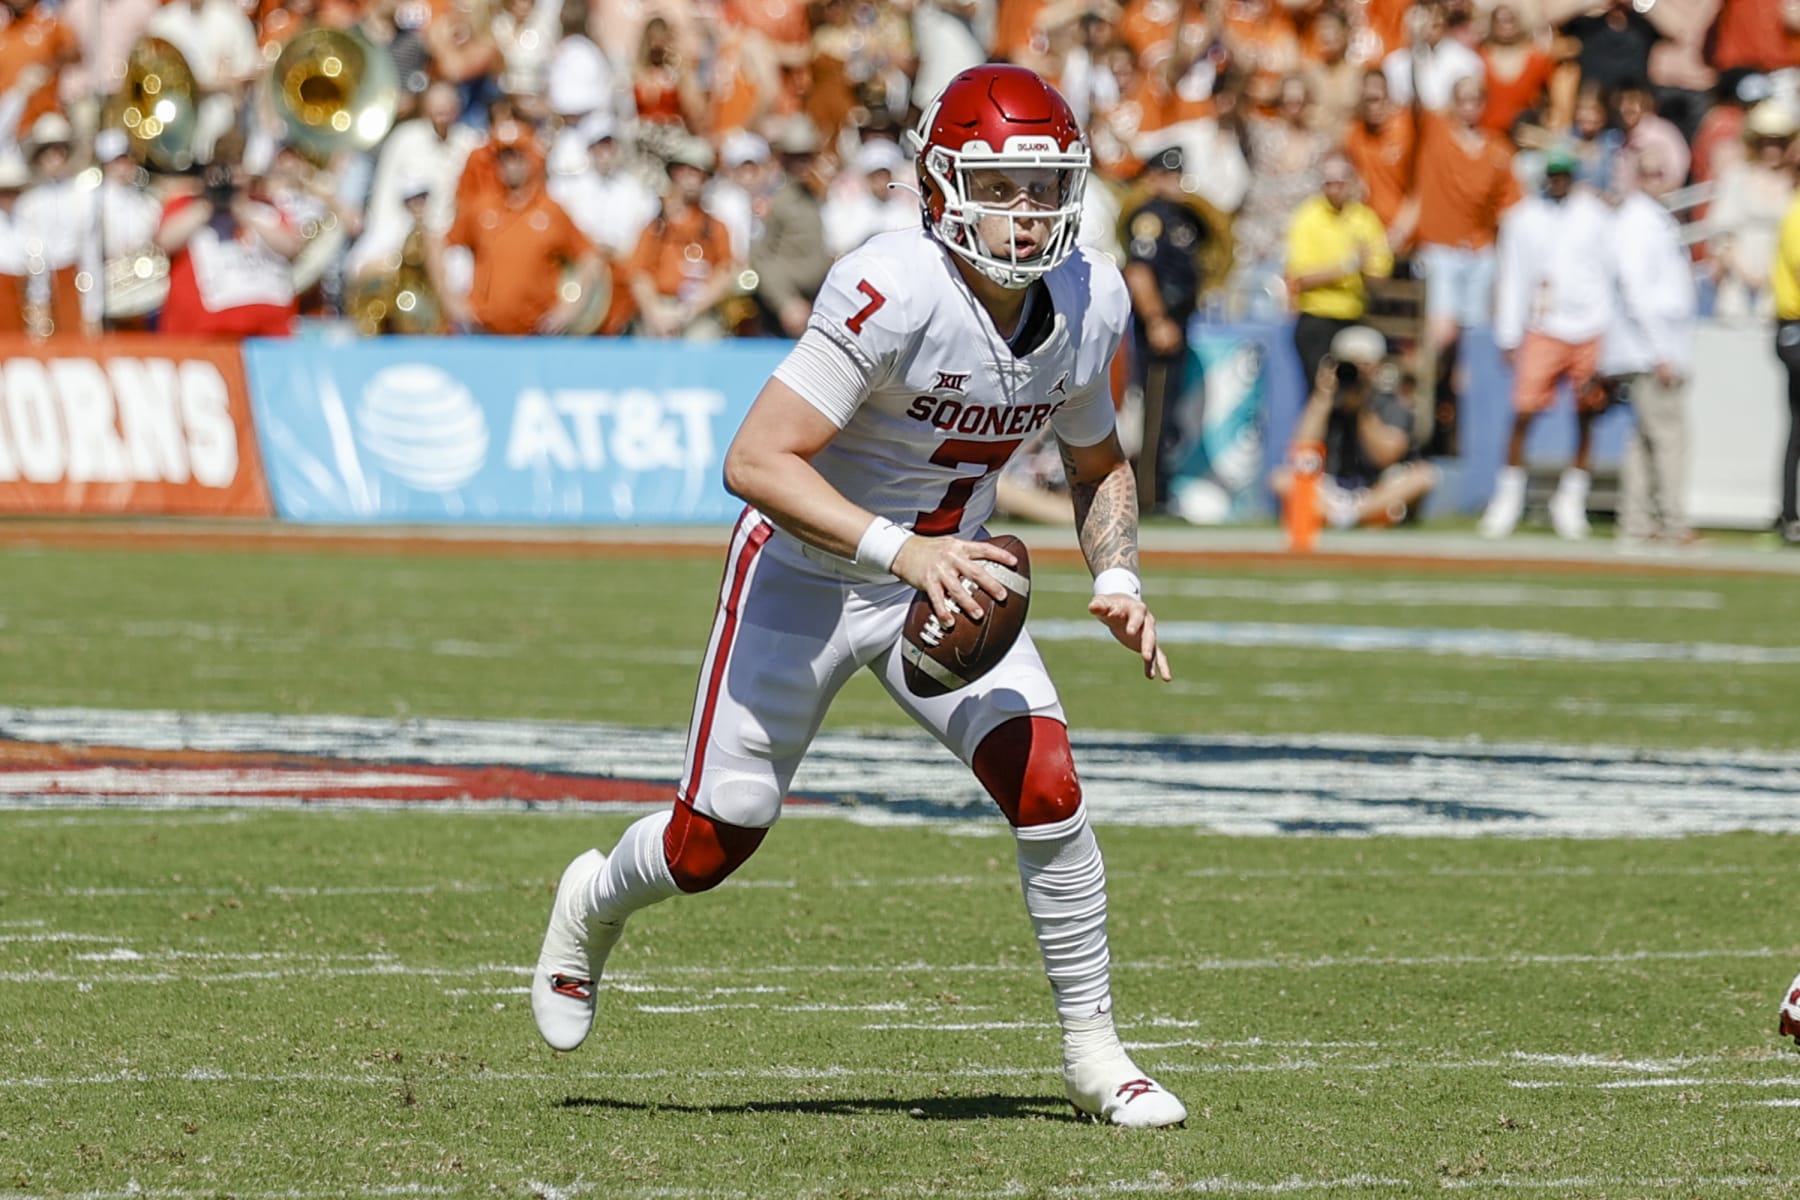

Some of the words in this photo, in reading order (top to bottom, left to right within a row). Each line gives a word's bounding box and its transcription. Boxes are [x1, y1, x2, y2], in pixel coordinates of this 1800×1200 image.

[845, 278, 887, 336] 7
[0, 357, 239, 488] ORNS
[506, 388, 726, 471] AT&T
[912, 438, 1024, 536] 7
